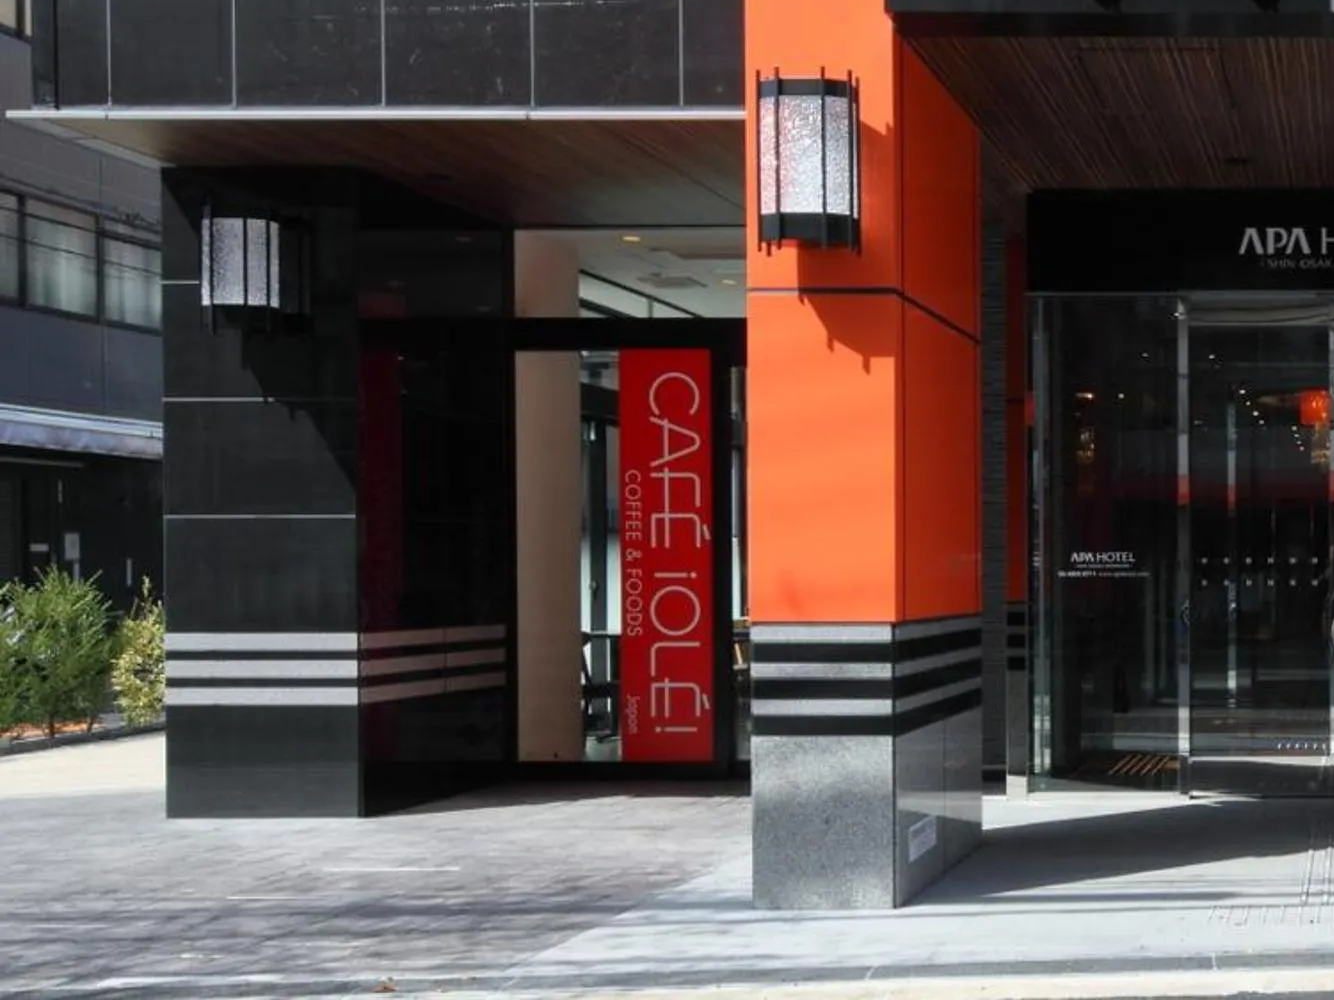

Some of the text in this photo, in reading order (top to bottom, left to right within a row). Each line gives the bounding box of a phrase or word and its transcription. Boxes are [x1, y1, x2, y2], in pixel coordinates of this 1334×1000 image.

[1238, 227, 1311, 255] APA
[648, 371, 711, 549] CAFÉ
[625, 469, 643, 637] COFFEE & FOODS
[1096, 551, 1136, 562] HOTEL
